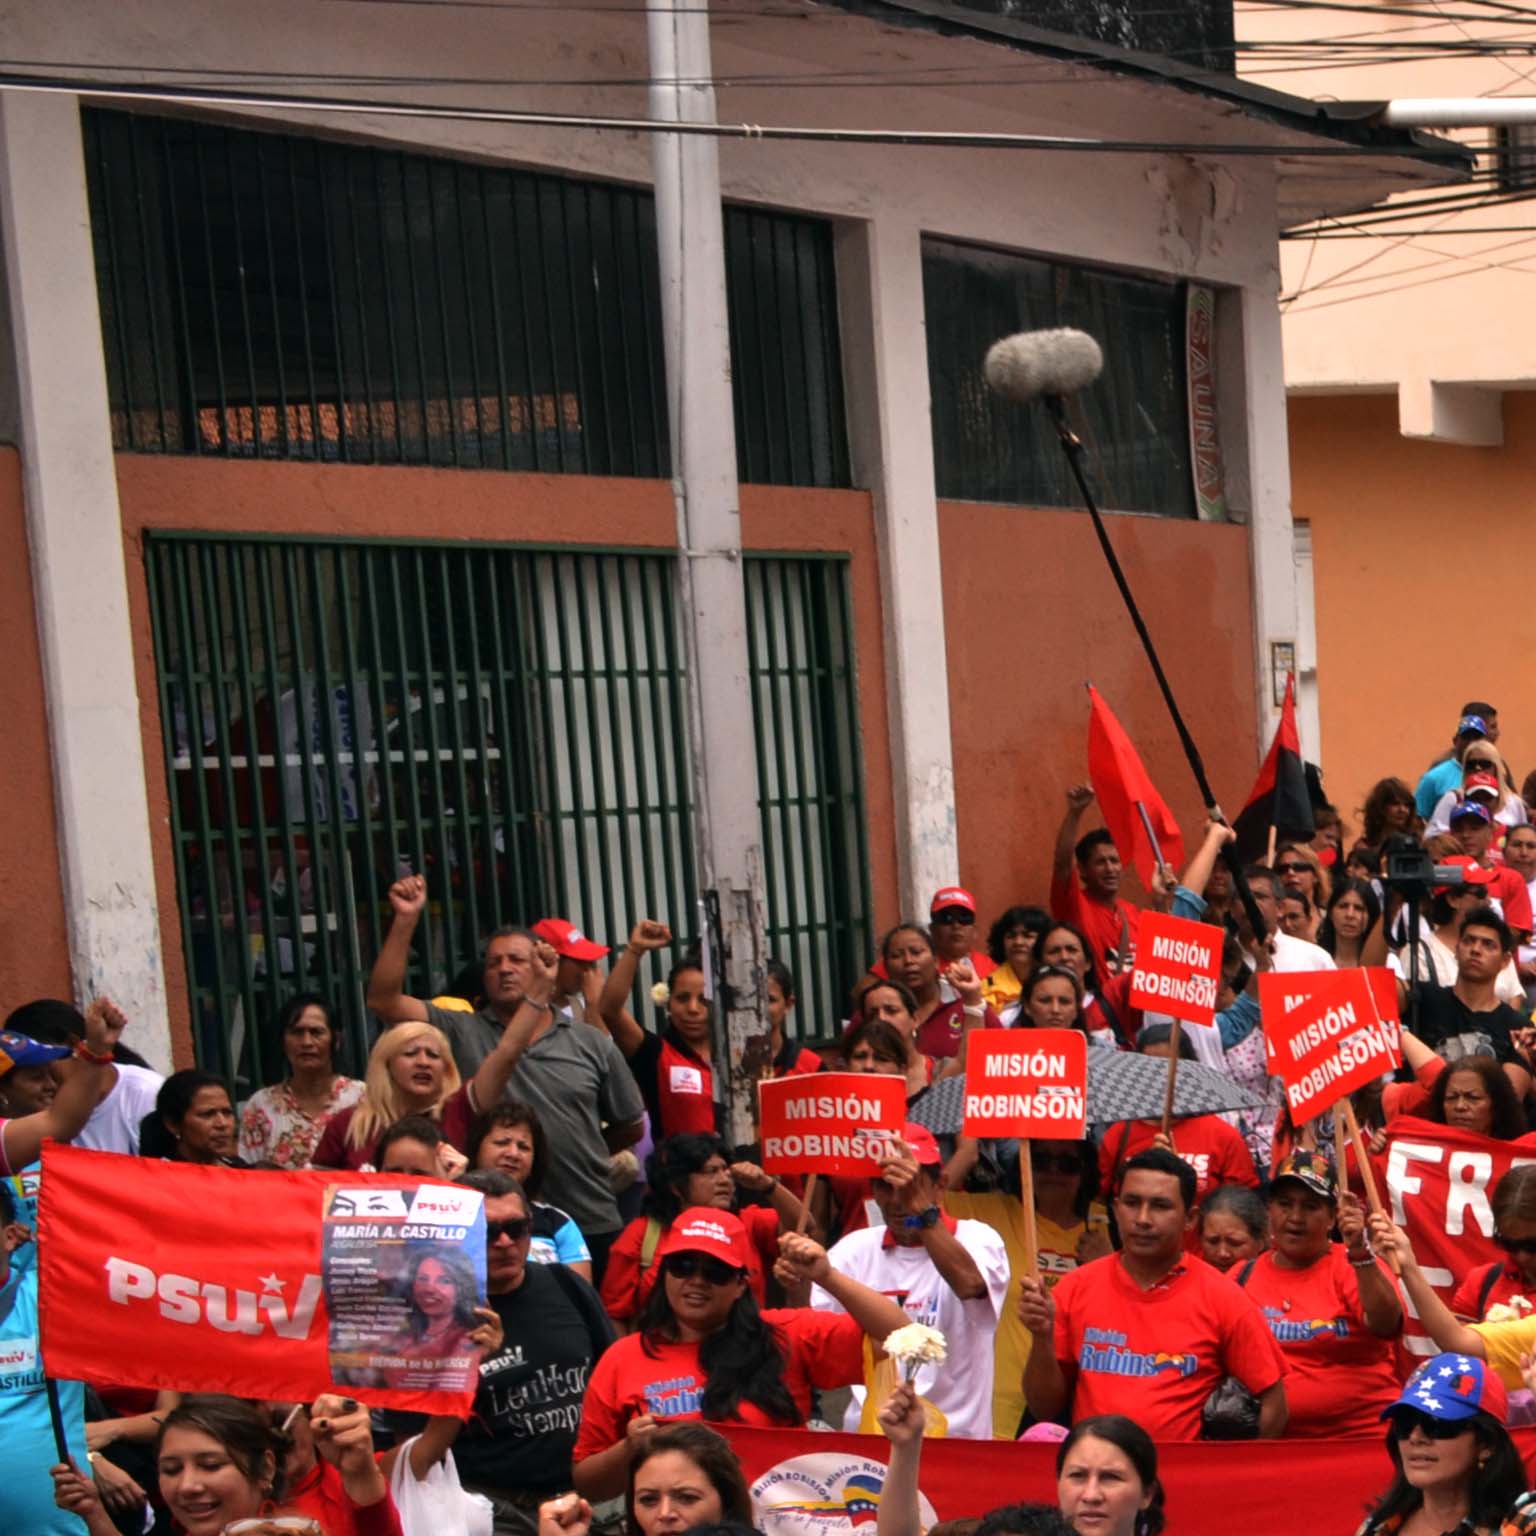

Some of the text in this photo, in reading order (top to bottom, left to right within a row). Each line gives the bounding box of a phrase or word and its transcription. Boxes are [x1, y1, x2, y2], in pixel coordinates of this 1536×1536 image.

[1152, 936, 1211, 970] MISIÓN
[1132, 970, 1217, 1009] ROBINSON
[1289, 1002, 1357, 1061] MISIÓN
[985, 1049, 1066, 1078] MISIÓN
[1288, 1025, 1383, 1108] ROBINSON
[784, 1093, 881, 1122] MISIÓN
[966, 1094, 1083, 1120] ROBINSON
[765, 1135, 903, 1161] ROBINSON
[332, 1223, 467, 1241] MARÍA A. CASTILLO
